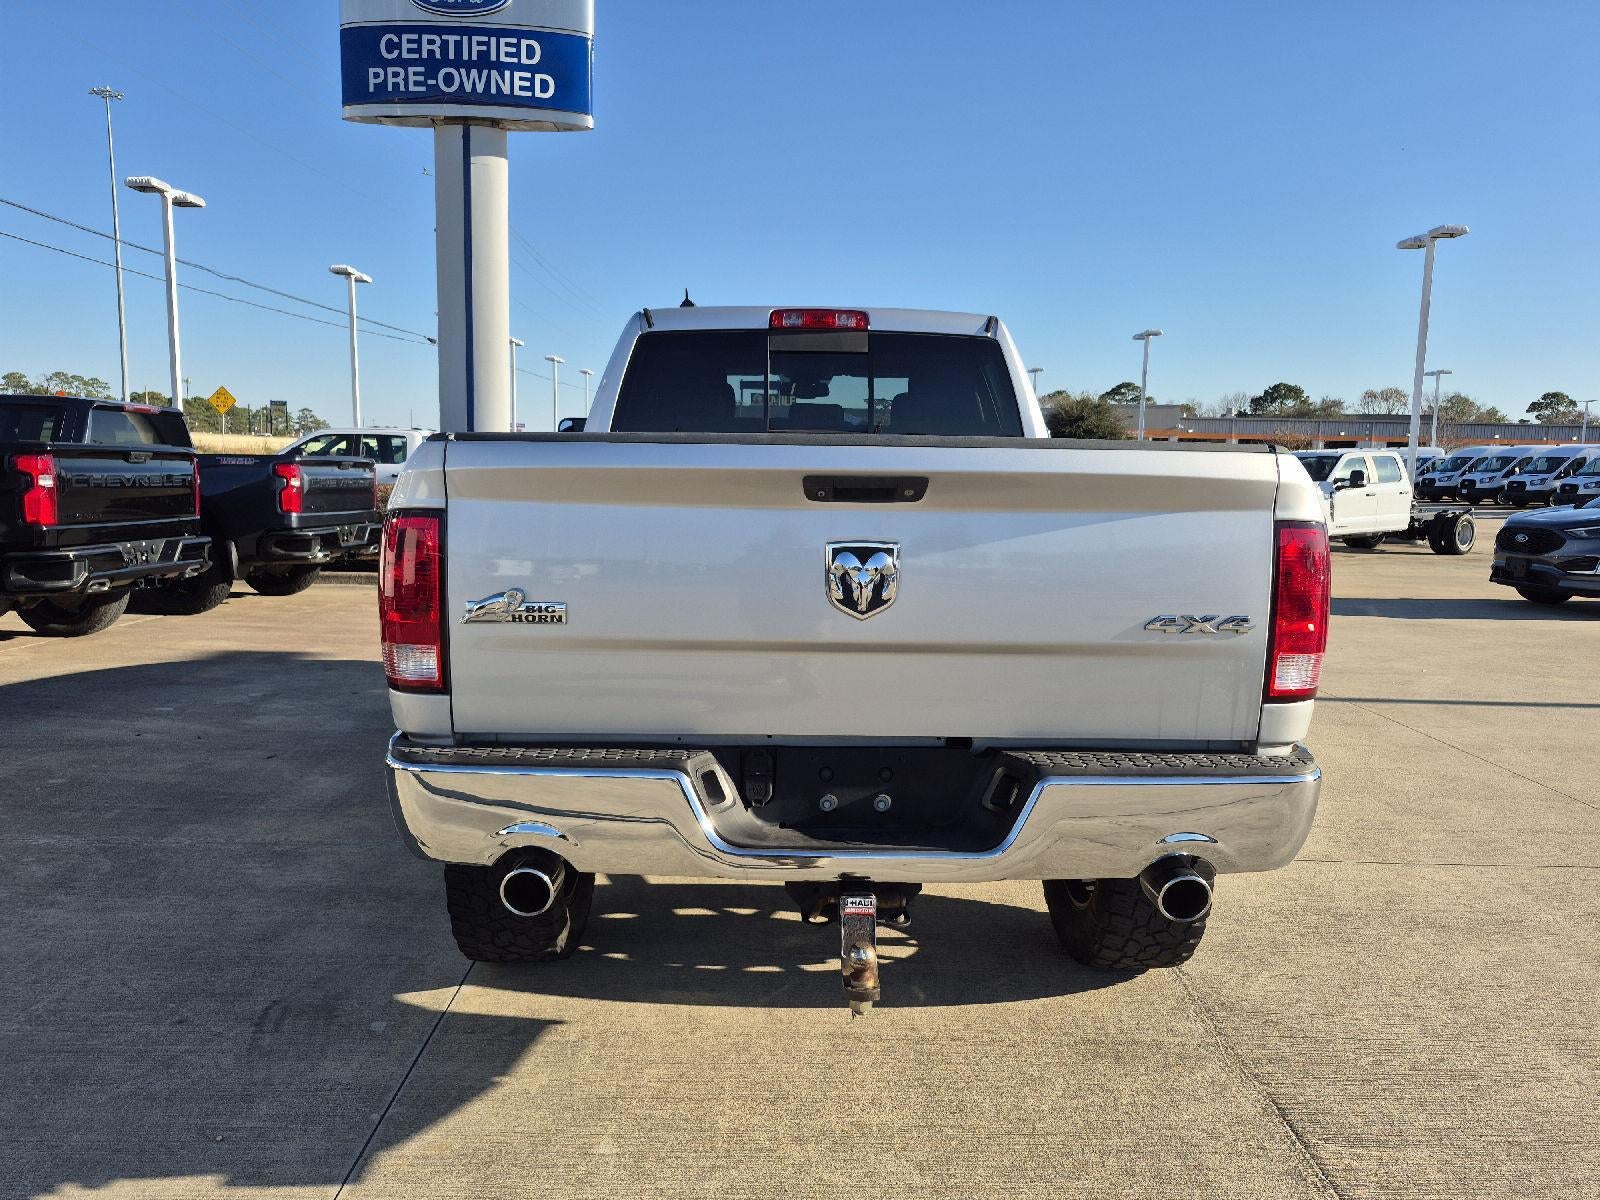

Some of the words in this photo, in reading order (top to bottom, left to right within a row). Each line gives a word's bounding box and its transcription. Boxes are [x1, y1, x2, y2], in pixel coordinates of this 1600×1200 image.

[380, 33, 541, 65] CERTIFIED
[368, 66, 555, 98] PRE-OWNED
[71, 473, 193, 488] CHEVROLET
[525, 605, 557, 613] BIG
[511, 614, 563, 623] HORN
